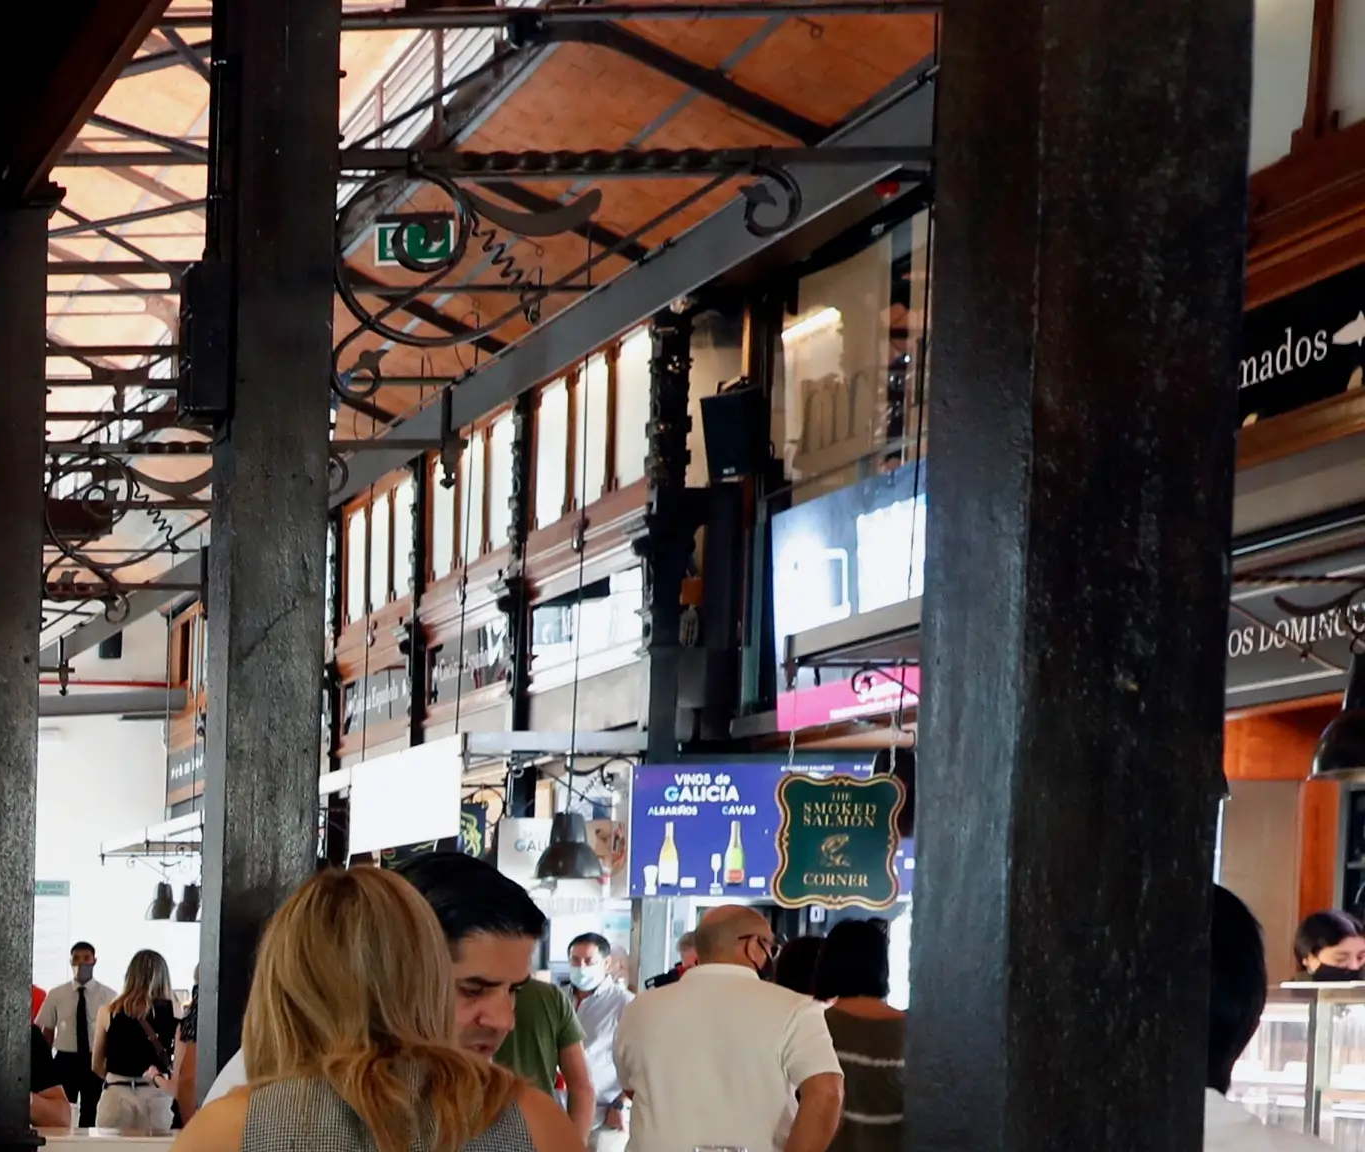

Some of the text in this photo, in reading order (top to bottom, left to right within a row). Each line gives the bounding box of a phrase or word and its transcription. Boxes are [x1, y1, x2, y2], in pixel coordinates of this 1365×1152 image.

[1237, 326, 1328, 389] mados
[674, 773, 731, 786] VINOS de
[664, 785, 740, 803] GALICIA
[831, 791, 852, 801] THE
[721, 804, 757, 816] CAVAS
[803, 801, 877, 815] SMOKED
[803, 814, 876, 828] SALMON
[803, 873, 869, 888] CORNER
